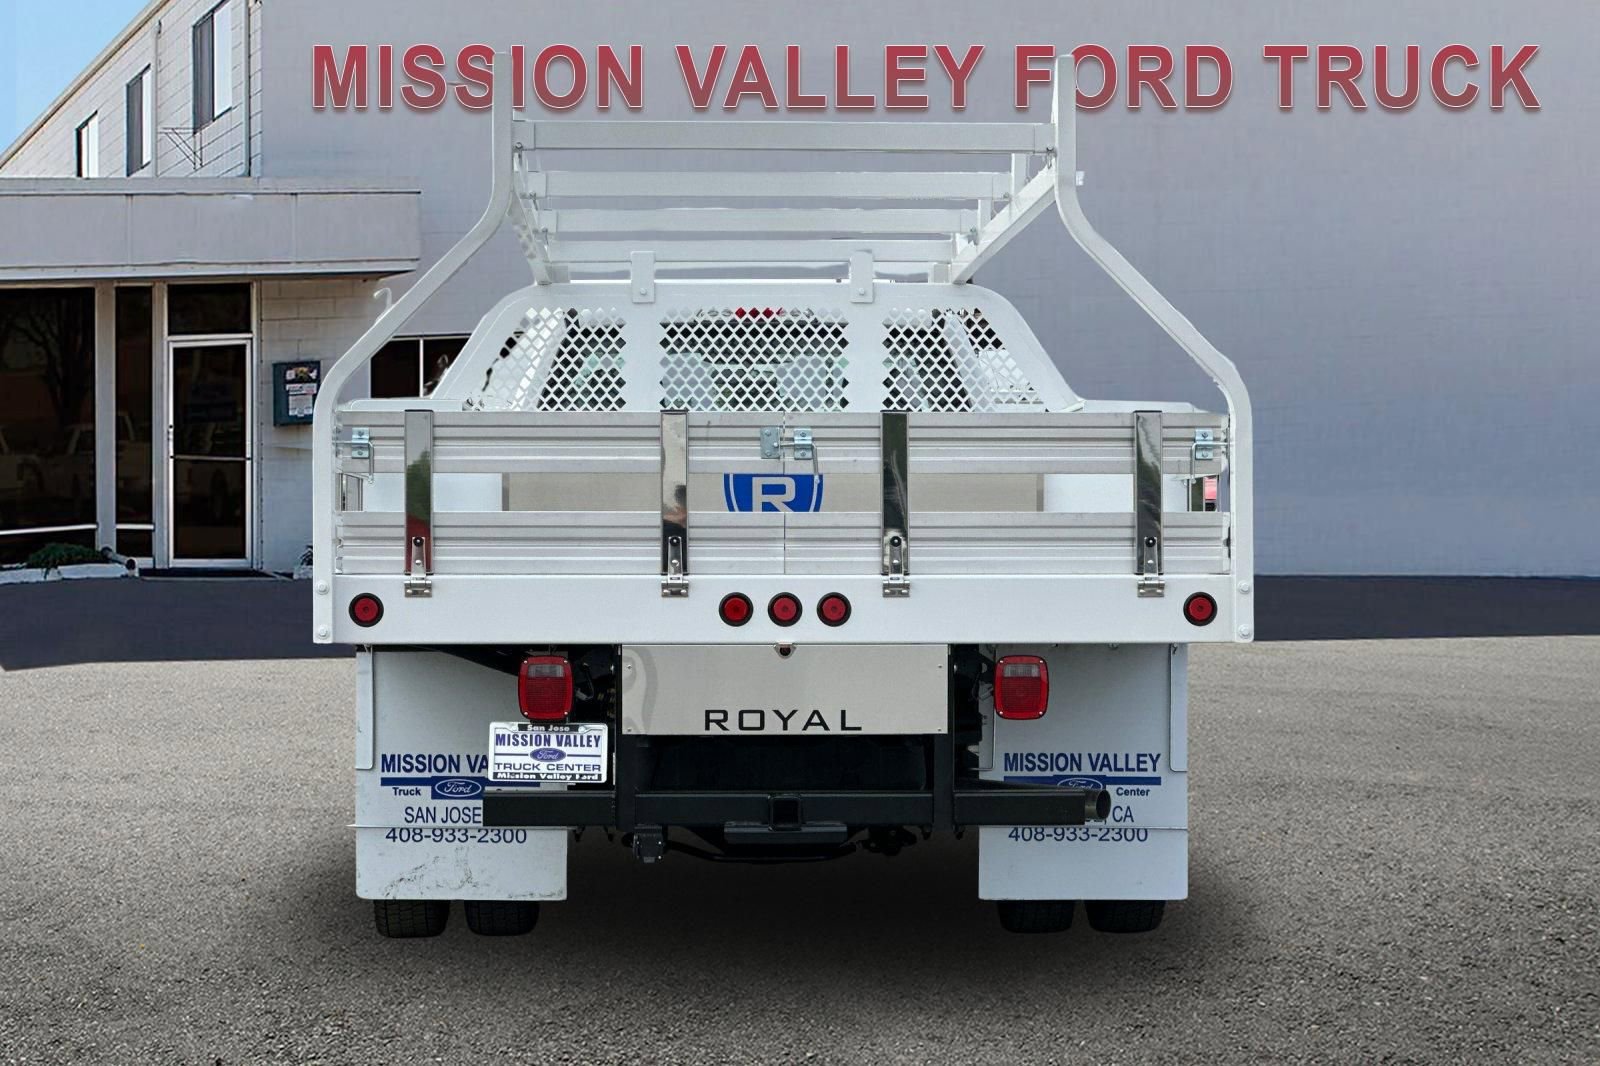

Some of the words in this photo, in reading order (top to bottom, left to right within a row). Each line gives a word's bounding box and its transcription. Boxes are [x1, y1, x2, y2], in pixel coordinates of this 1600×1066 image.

[312, 44, 644, 110] MISSION
[675, 44, 985, 108] VALLEY
[1014, 44, 1234, 109] FORD
[1263, 44, 1541, 109] TRUCK
[704, 709, 862, 731] ROYAL
[495, 733, 552, 747] MISSION
[556, 734, 601, 748] VALLEY
[536, 750, 559, 760] Ford
[1003, 753, 1082, 772] MISSION
[1088, 753, 1161, 772] VALLEY
[381, 754, 461, 773] MISSION
[495, 762, 541, 771] TRUCK
[546, 763, 602, 772] CENTER
[393, 787, 422, 796] Truck
[444, 781, 473, 794] Ford
[1116, 787, 1150, 796] Center
[404, 806, 436, 824] SAN
[441, 806, 482, 824] JOSE
[1112, 805, 1134, 823] CA
[385, 828, 527, 844] 408-933-2300
[1008, 828, 1148, 842] 408-933-2300
